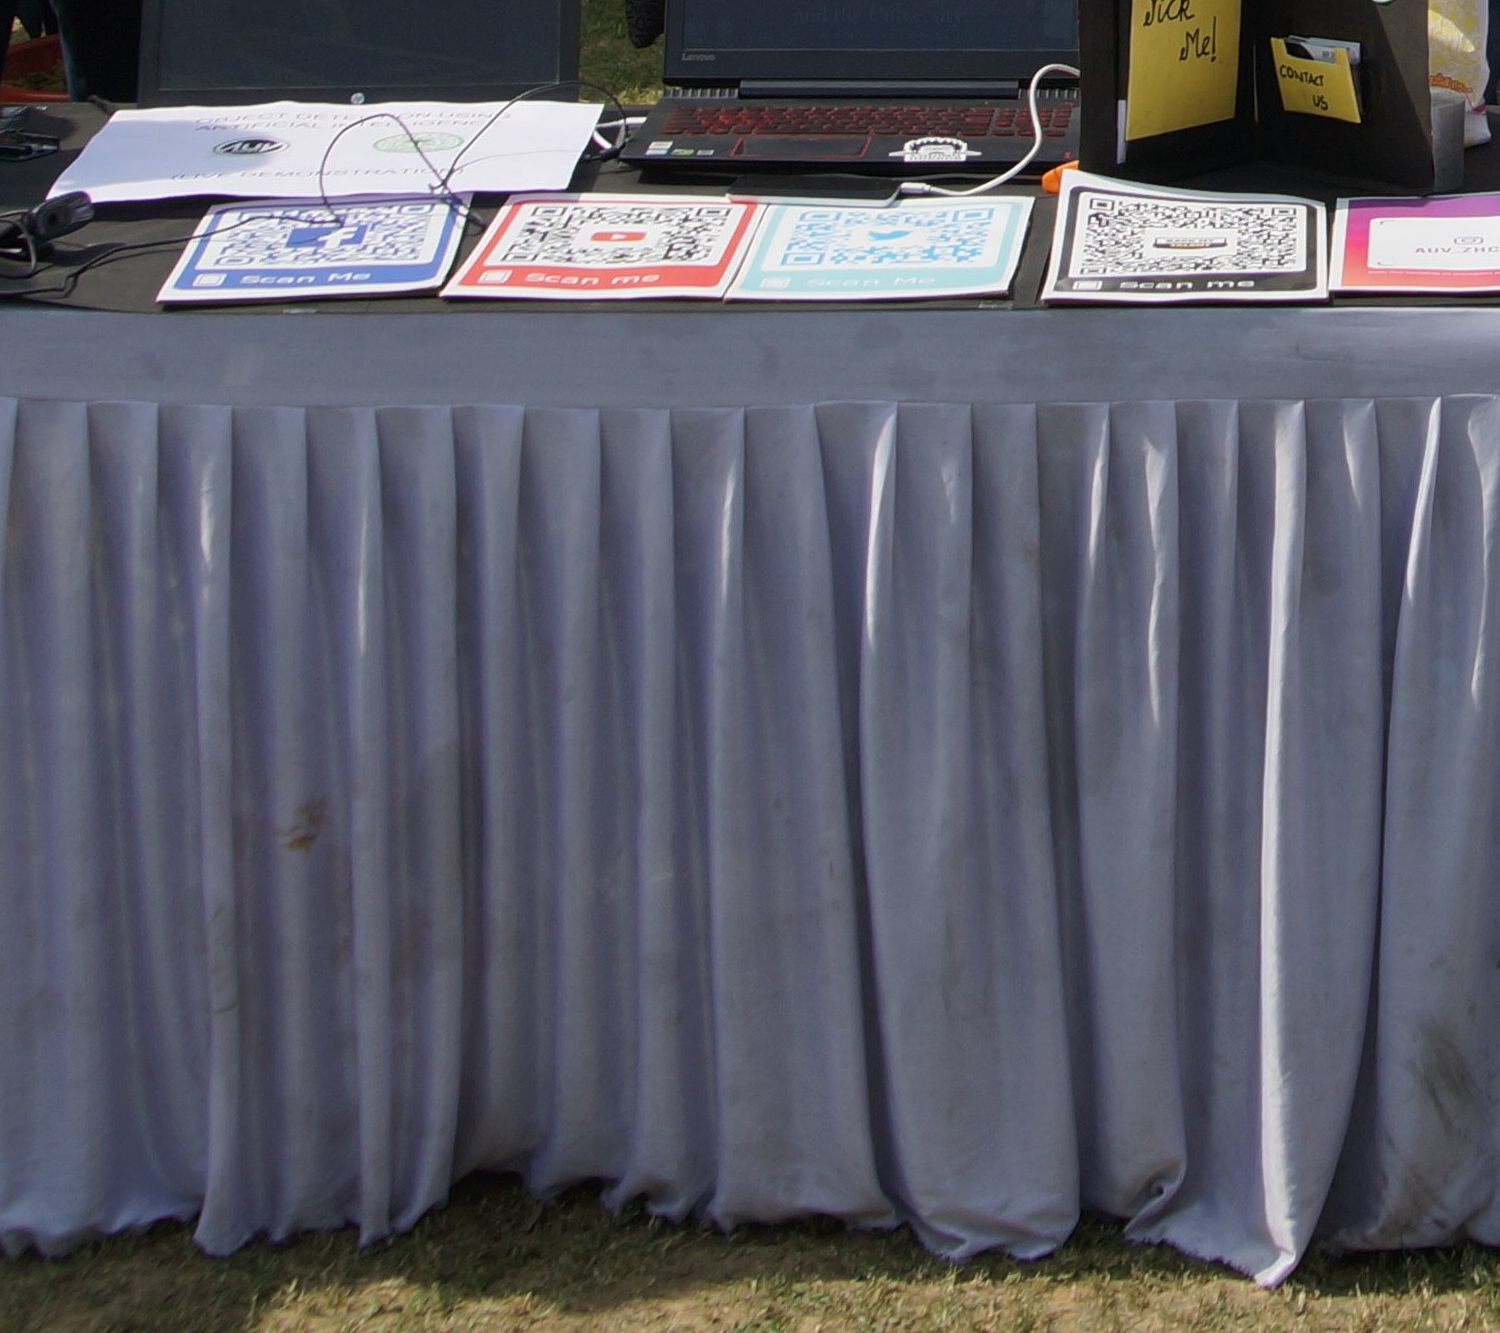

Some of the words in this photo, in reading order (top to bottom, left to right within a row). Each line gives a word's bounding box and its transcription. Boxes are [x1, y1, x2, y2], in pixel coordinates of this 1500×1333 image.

[1178, 15, 1219, 64] Me!
[680, 52, 717, 62] Lenovo
[1278, 63, 1325, 88] CONTACT
[1312, 93, 1330, 112] US
[239, 272, 333, 286] Scan
[340, 271, 371, 283] Me
[523, 272, 601, 286] Scan
[611, 273, 661, 285] me
[806, 276, 881, 289] Scan
[893, 275, 935, 287] Me
[1207, 277, 1256, 290] me
